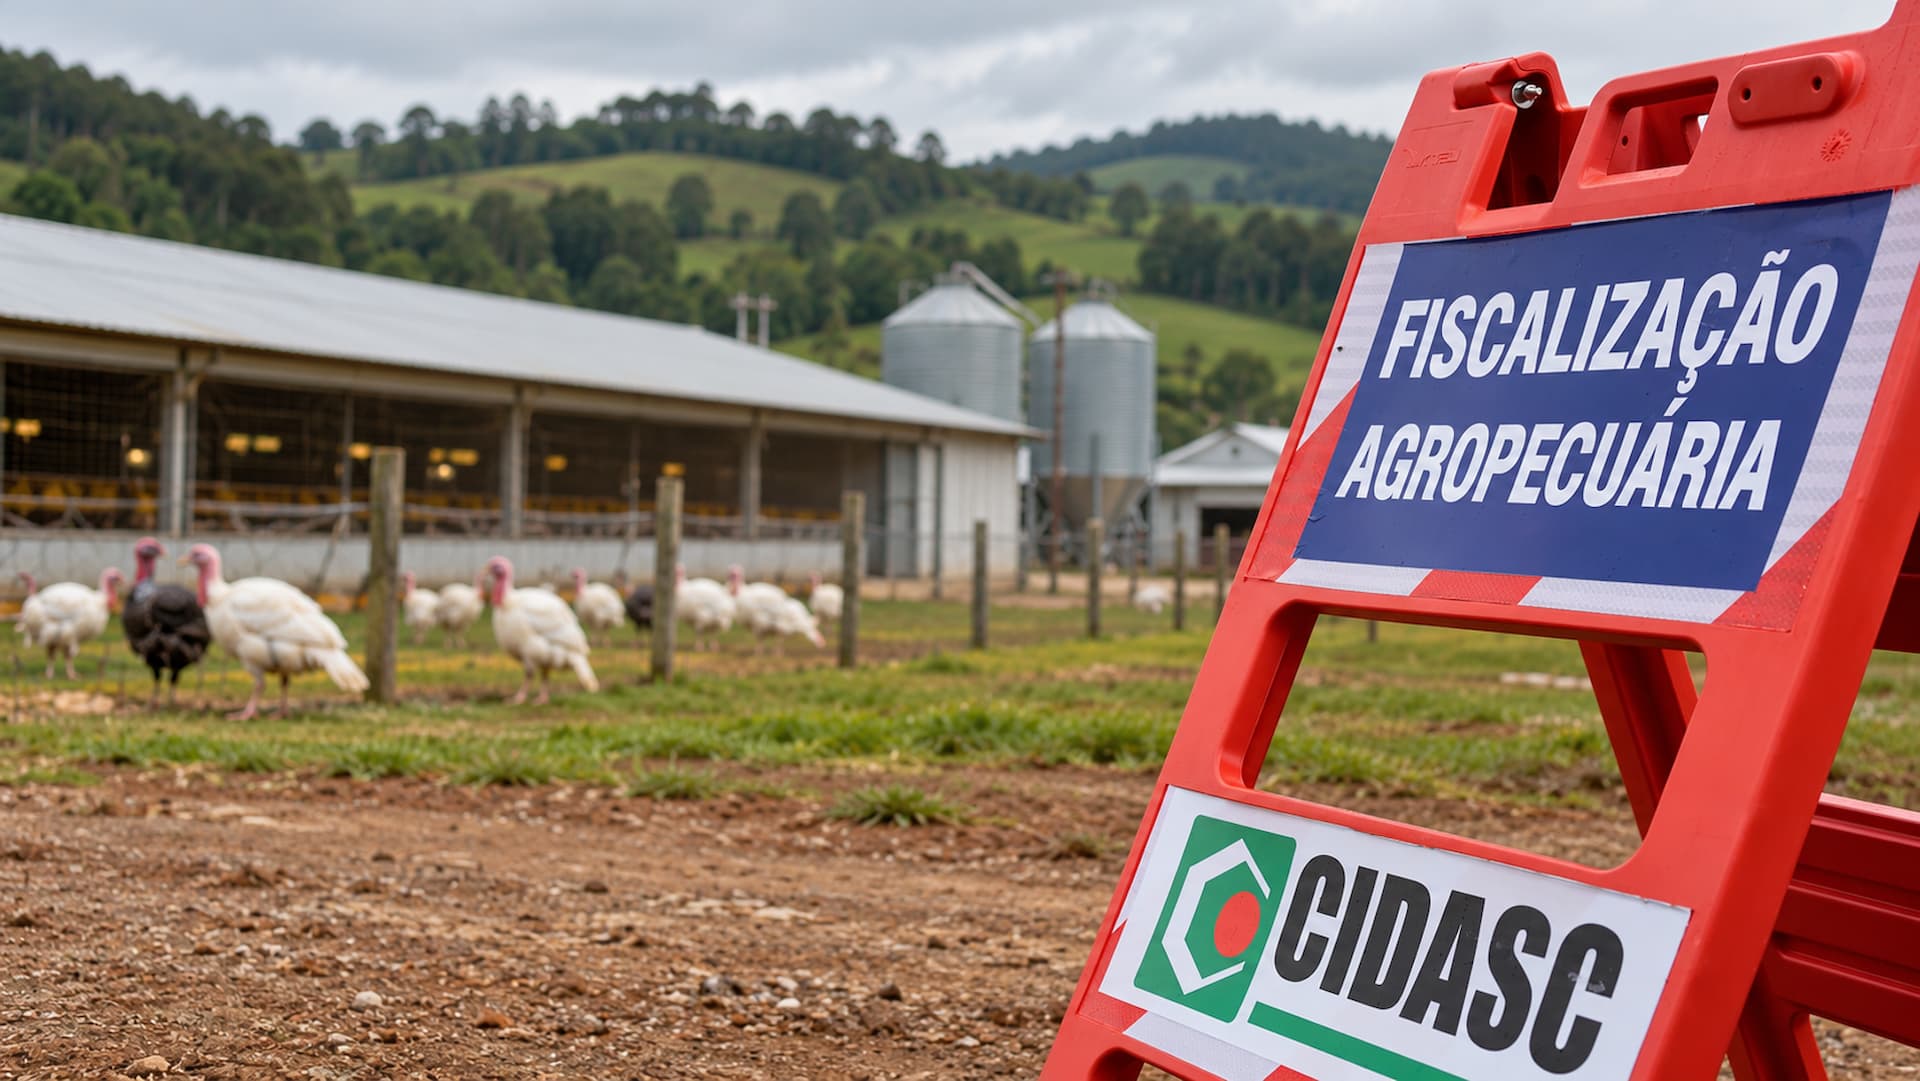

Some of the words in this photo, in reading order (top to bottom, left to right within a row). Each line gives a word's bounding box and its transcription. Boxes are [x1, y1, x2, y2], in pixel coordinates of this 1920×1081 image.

[1379, 249, 1839, 394] FISCALIZAÇÃO
[1335, 397, 1782, 511] AGROPECUÁRIA
[1274, 854, 1624, 1075] CIDASC
